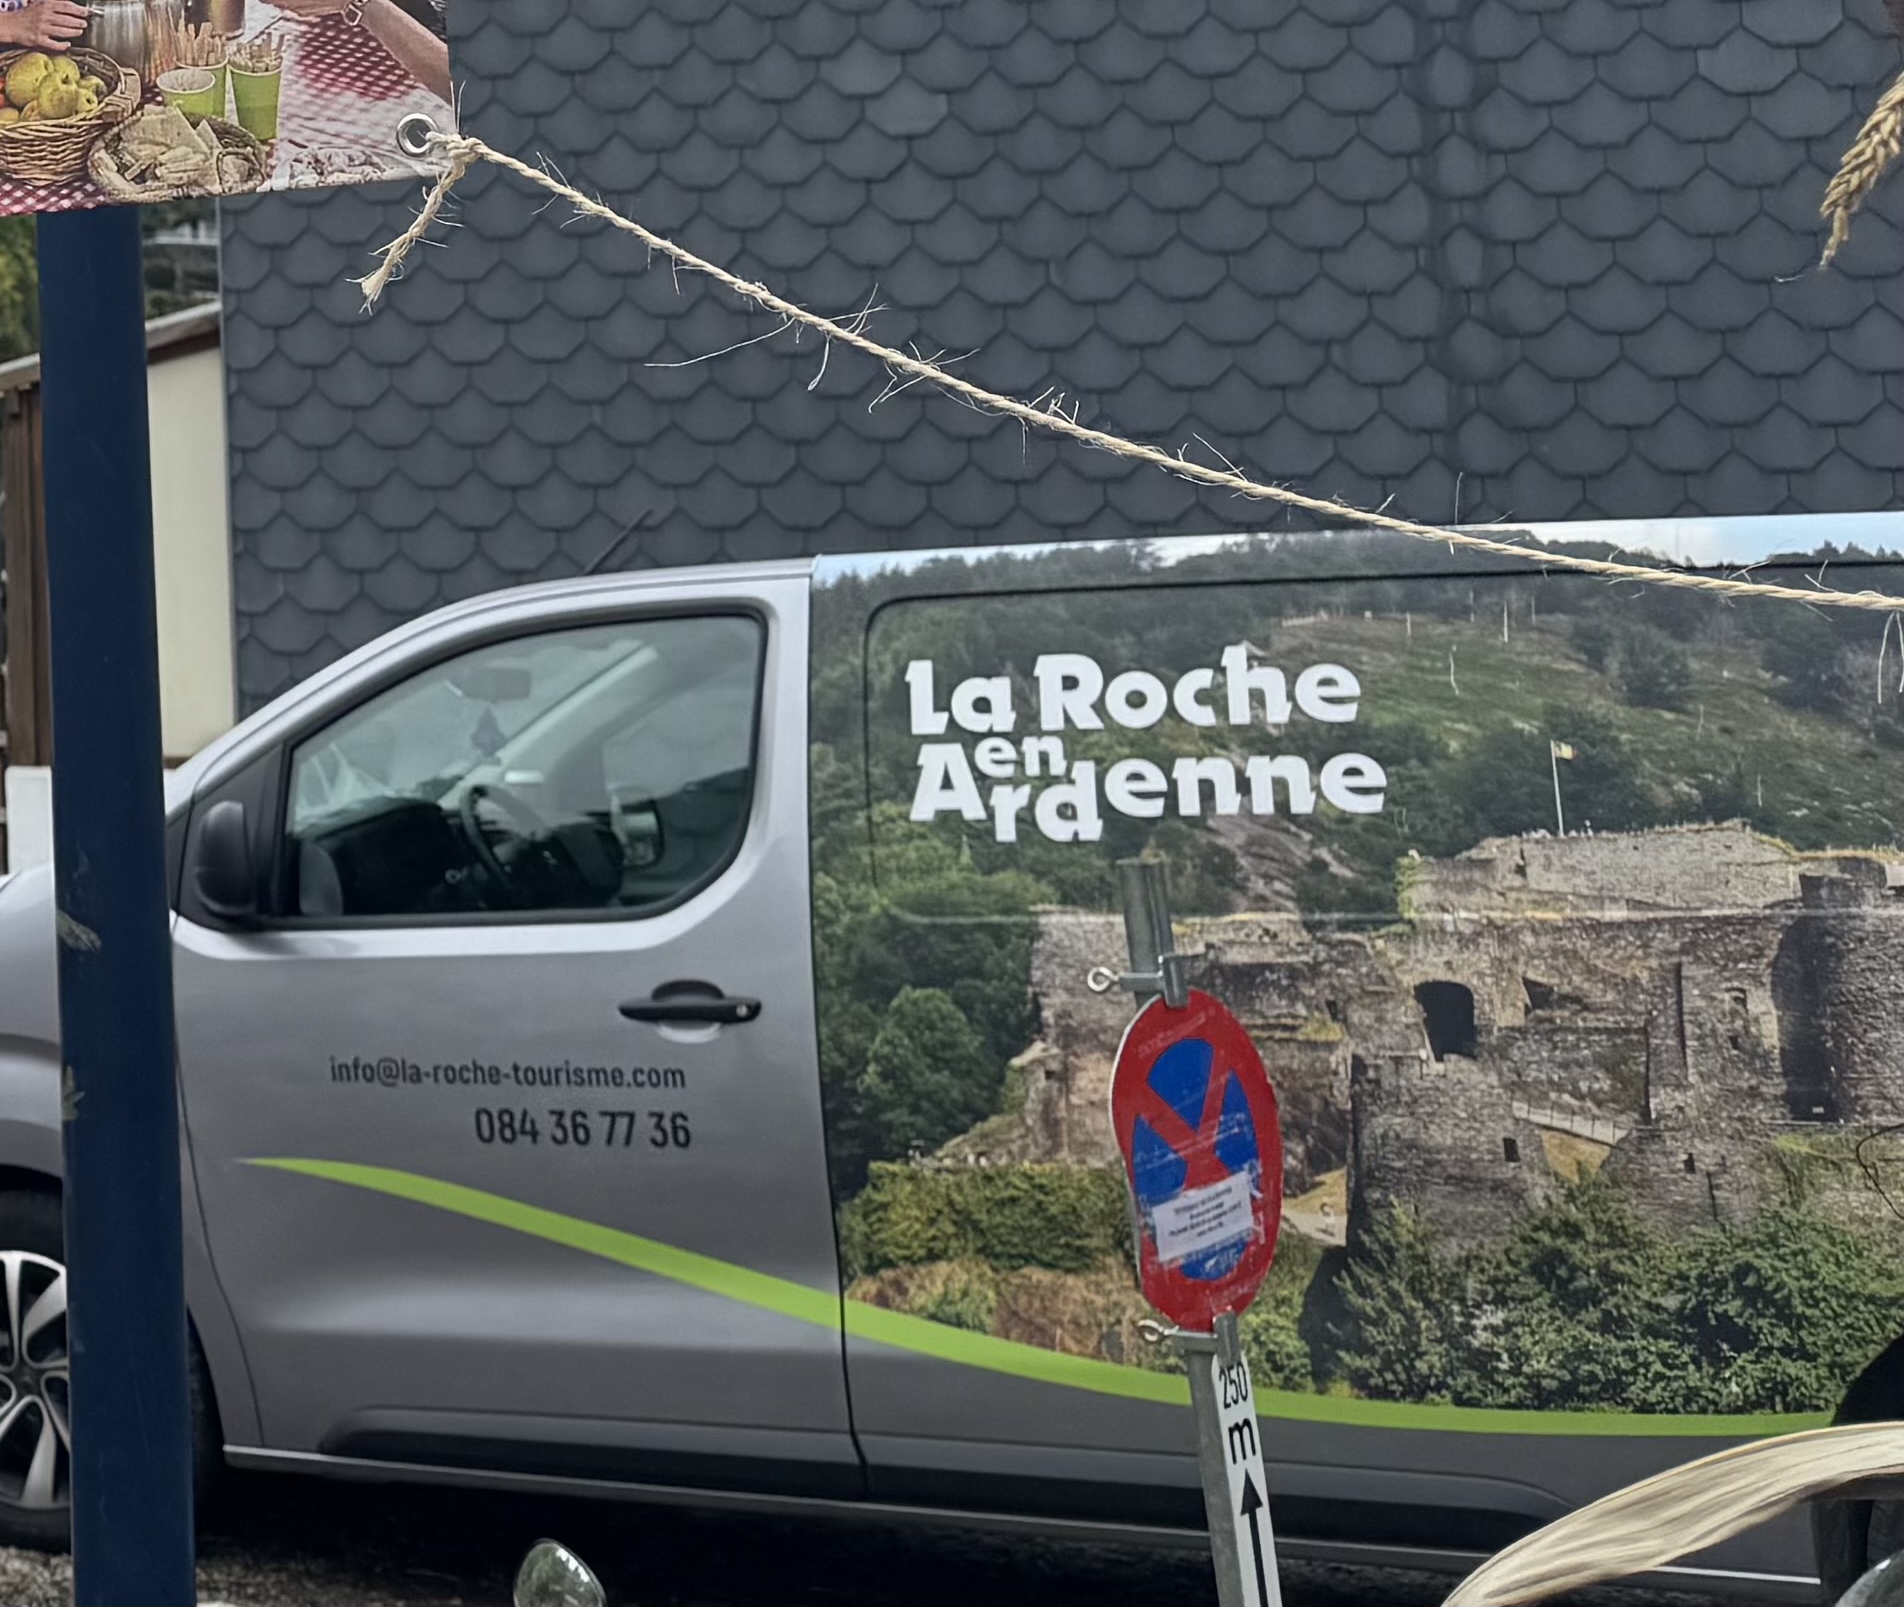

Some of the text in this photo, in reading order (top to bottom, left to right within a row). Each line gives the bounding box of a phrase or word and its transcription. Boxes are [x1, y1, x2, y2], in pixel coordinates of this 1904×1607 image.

[904, 641, 1362, 736] La Roche
[974, 735, 1068, 779] en
[909, 743, 1389, 843] Ardenne
[329, 1056, 687, 1089] info@la-roche-tourisme.com
[474, 1107, 692, 1149] 084 36 77 36
[1218, 1360, 1249, 1409] 250
[1228, 1417, 1257, 1465] m
